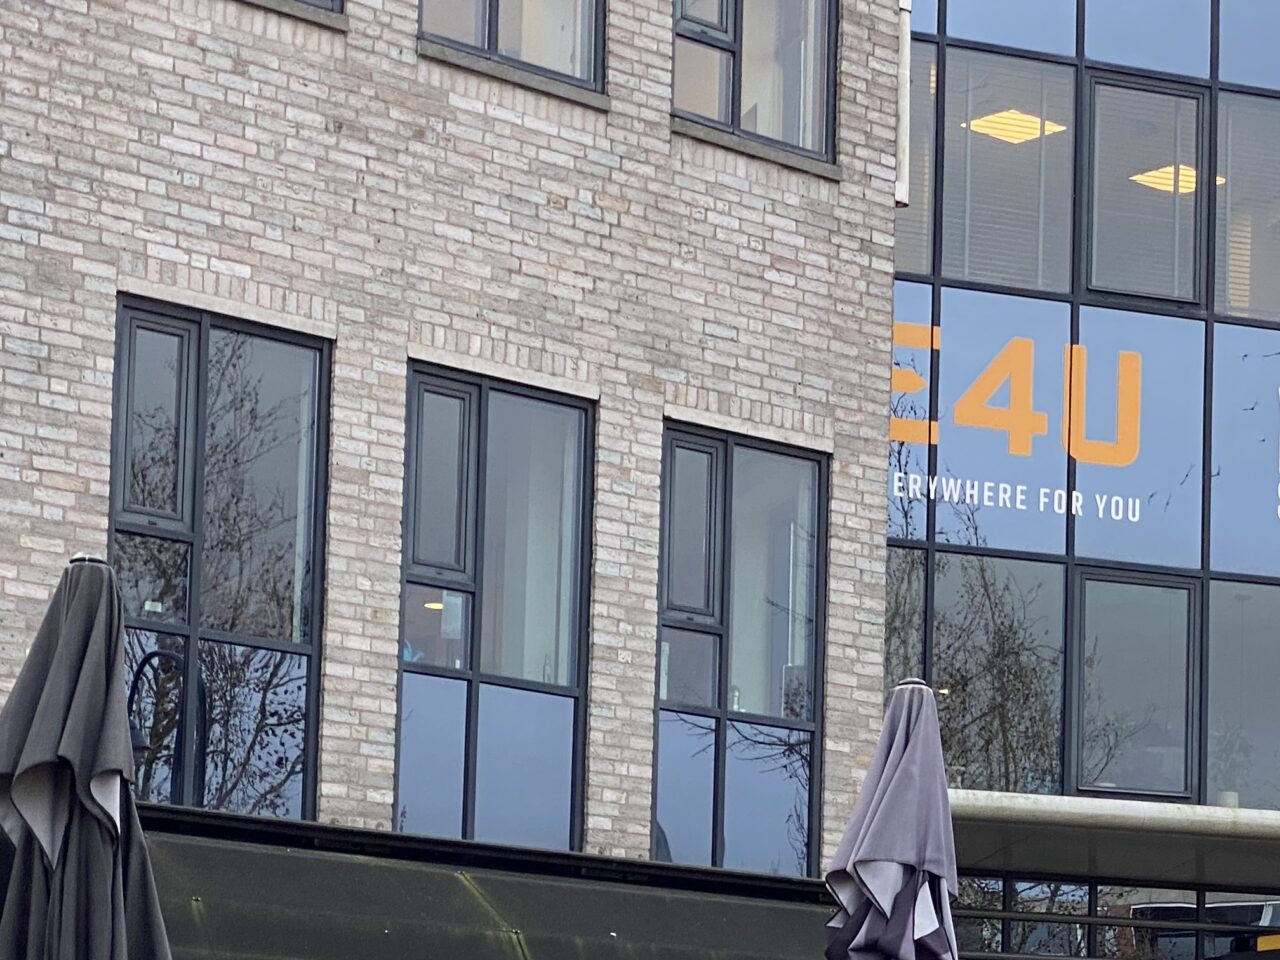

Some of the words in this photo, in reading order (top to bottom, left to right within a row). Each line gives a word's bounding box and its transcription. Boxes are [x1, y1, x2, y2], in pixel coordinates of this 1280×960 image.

[893, 472, 1028, 511] ERYWHERE
[1039, 488, 1083, 516] FOR
[1095, 493, 1140, 523] YOU
